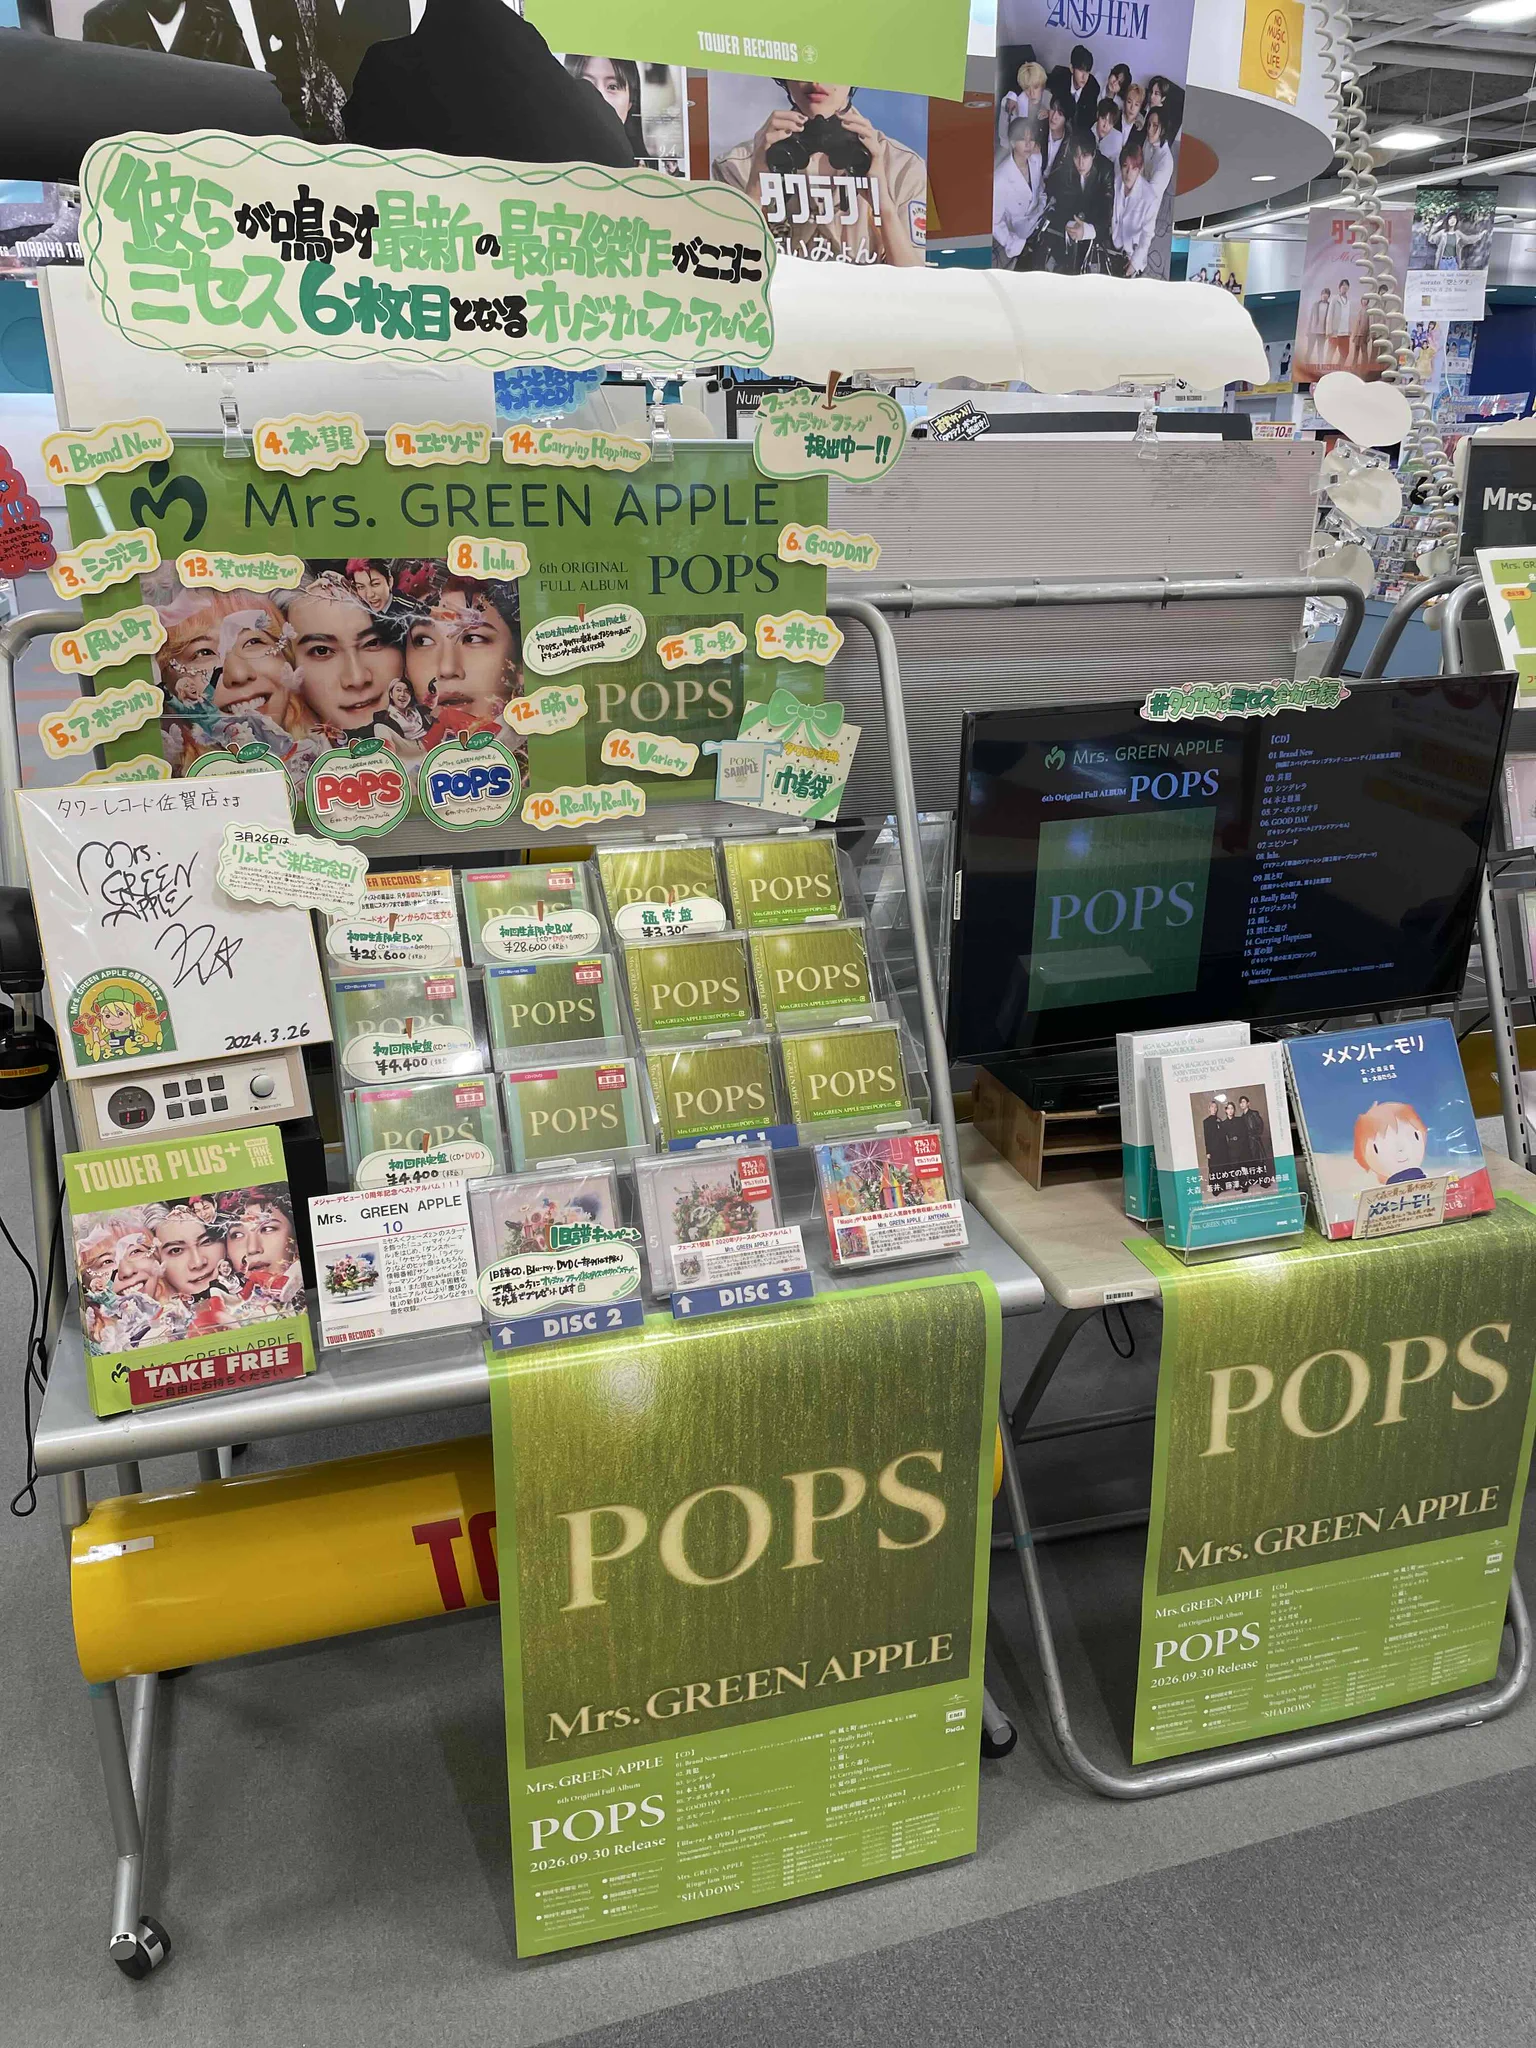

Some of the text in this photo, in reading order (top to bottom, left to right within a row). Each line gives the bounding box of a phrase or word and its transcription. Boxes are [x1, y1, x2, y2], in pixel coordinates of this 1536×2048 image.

[1274, 15, 1282, 27] NO
[698, 31, 798, 62] TOWER RECORDS
[1271, 42, 1280, 53] NO
[103, 152, 764, 284] 彼らが鳴らす最新の最高傑作がここに
[49, 431, 163, 475] 1. Brand New
[264, 431, 288, 455] 4.
[395, 427, 485, 455] 7. エピソード
[509, 431, 643, 463] 14. Carrying Happiness
[245, 483, 779, 528] Mrs. GREEN APPLE
[59, 565, 85, 588] 3.
[183, 557, 299, 581] 13. 禁じた遊び
[539, 561, 629, 574] 6th ORIGINAL
[648, 553, 780, 596] POPS
[539, 578, 629, 592] FULL ALBUM
[61, 618, 153, 665] 9. 風と町
[662, 631, 737, 662] 15. 夏の影
[763, 626, 782, 644] 2.
[511, 703, 540, 722] 12.
[595, 678, 735, 724] POPS
[609, 738, 688, 772] 16. Variety
[1073, 738, 1224, 765] Mrs. GREEN APPLE
[430, 766, 513, 805] POPS
[724, 763, 759, 779] SAMPLE
[1128, 768, 1220, 803] POPS
[1505, 766, 1515, 794] Variety
[58, 787, 241, 819] タワーレコード佐賀店さま
[316, 770, 404, 812] POPS
[1042, 787, 1127, 803] 6th Original Full ALBUM
[530, 798, 559, 821] 10.
[101, 851, 199, 906] GREEN
[749, 873, 832, 903] POPS
[641, 906, 694, 925] 通常盤
[1047, 881, 1195, 941] POPS
[76, 974, 100, 995] GREEN
[100, 969, 128, 979] APPLE
[650, 976, 741, 1010] POPS
[775, 963, 861, 995] POPS
[509, 998, 596, 1029] POPS
[224, 1025, 311, 1051] 2024.3.26
[808, 1065, 897, 1101] POPS
[674, 1082, 766, 1119] POPS
[529, 1103, 619, 1137] POPS
[248, 1144, 273, 1158] TAKE
[251, 1154, 275, 1169] FREE
[74, 1154, 163, 1194] TOWER
[317, 1194, 462, 1226] Mrs. GREEN APPLE
[383, 1220, 403, 1234] 10
[719, 1279, 793, 1307] DISC 3
[326, 1328, 376, 1345] TOWER RECORDS
[543, 1308, 623, 1338] DISC 2
[144, 1360, 216, 1389] TAKE
[227, 1347, 291, 1375] FREE
[152, 1366, 285, 1399] ご自由にお持ちください
[1198, 1323, 1511, 1457] POPS
[556, 1449, 947, 1612] POPS
[1174, 1485, 1500, 1573] Mrs. GREEN APPLE
[1155, 1588, 1263, 1619] Mrs. GREEN APPLE
[1188, 1615, 1212, 1627] Original
[1212, 1613, 1224, 1622] Full
[1225, 1610, 1244, 1619] Album
[1151, 1621, 1260, 1670] POPS
[546, 1633, 954, 1744] Mrs. GREEN APPLE
[1150, 1667, 1214, 1688] 2026.09.30
[1217, 1659, 1259, 1675] Release
[526, 1755, 664, 1795] Mrs. GREEN APPLE
[557, 1781, 641, 1805] 6th Original Full Album
[528, 1794, 667, 1852] POPS
[529, 1836, 667, 1873] 2026.09.30 Release
[694, 1866, 721, 1878] GREEN
[722, 1861, 744, 1871] APPLE
